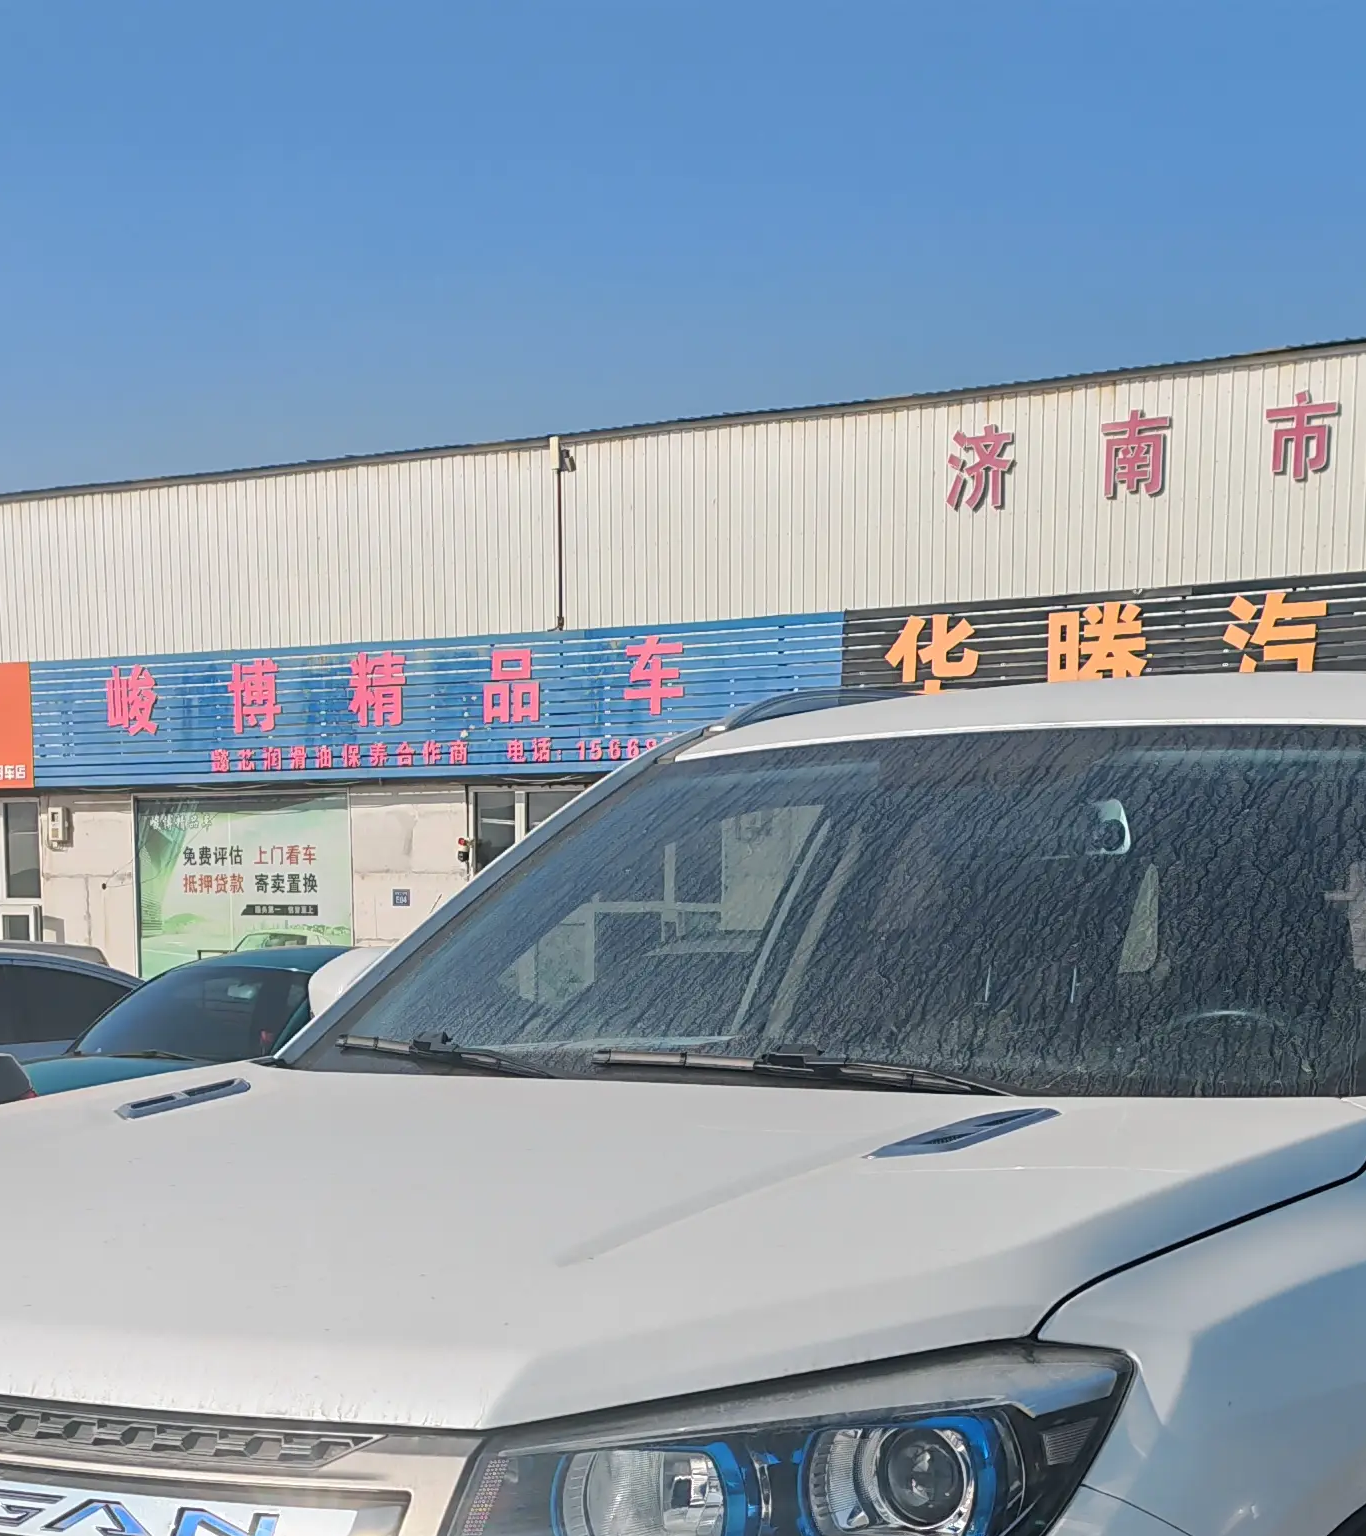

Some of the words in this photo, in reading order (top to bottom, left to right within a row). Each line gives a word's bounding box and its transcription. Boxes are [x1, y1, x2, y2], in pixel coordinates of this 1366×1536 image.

[106, 635, 686, 736] 峻博精品车
[182, 845, 244, 867] 免费评估
[253, 844, 318, 866] 上门看车
[182, 872, 245, 895] 抵押贷款
[254, 872, 319, 894] 寄卖置换
